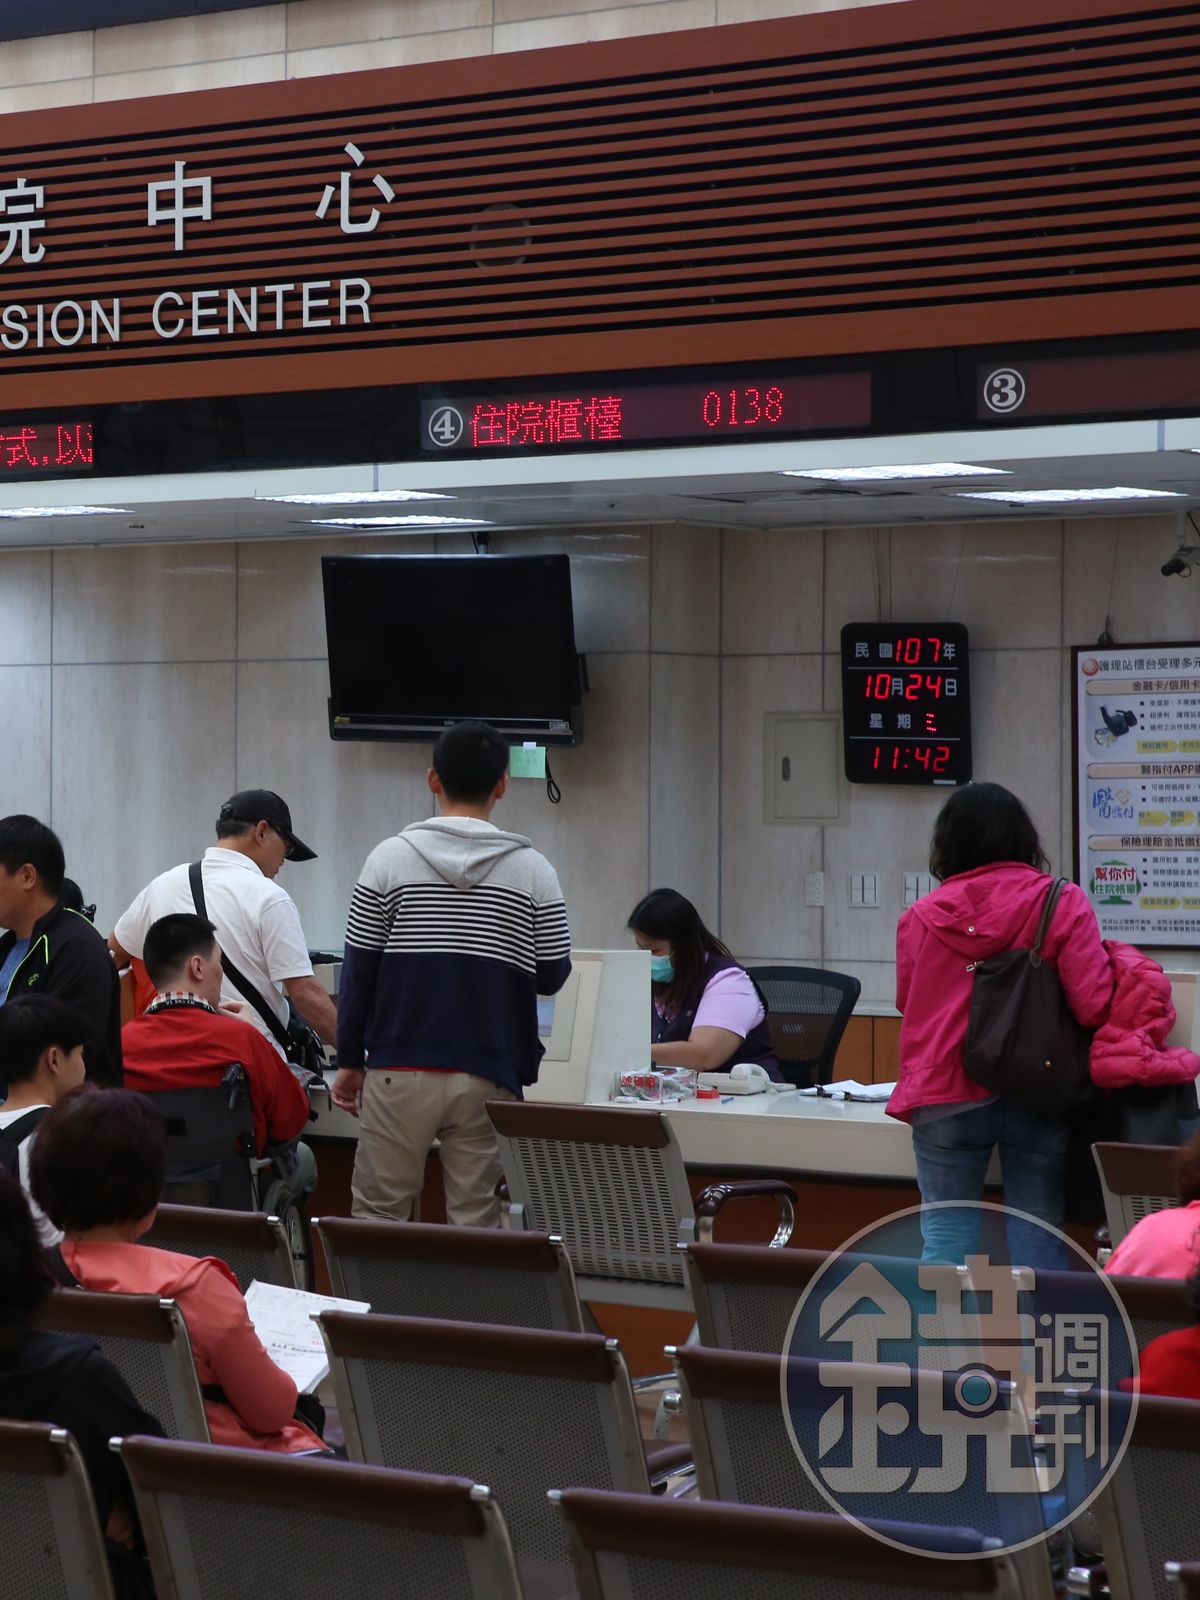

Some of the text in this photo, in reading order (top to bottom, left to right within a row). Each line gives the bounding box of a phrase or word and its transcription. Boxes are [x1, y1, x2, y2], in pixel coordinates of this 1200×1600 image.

[151, 277, 372, 339] CENTER
[990, 372, 1018, 408] 3
[431, 409, 458, 442] 4
[469, 386, 784, 447] 住院櫃檯 0138
[873, 746, 950, 772] 11:42
